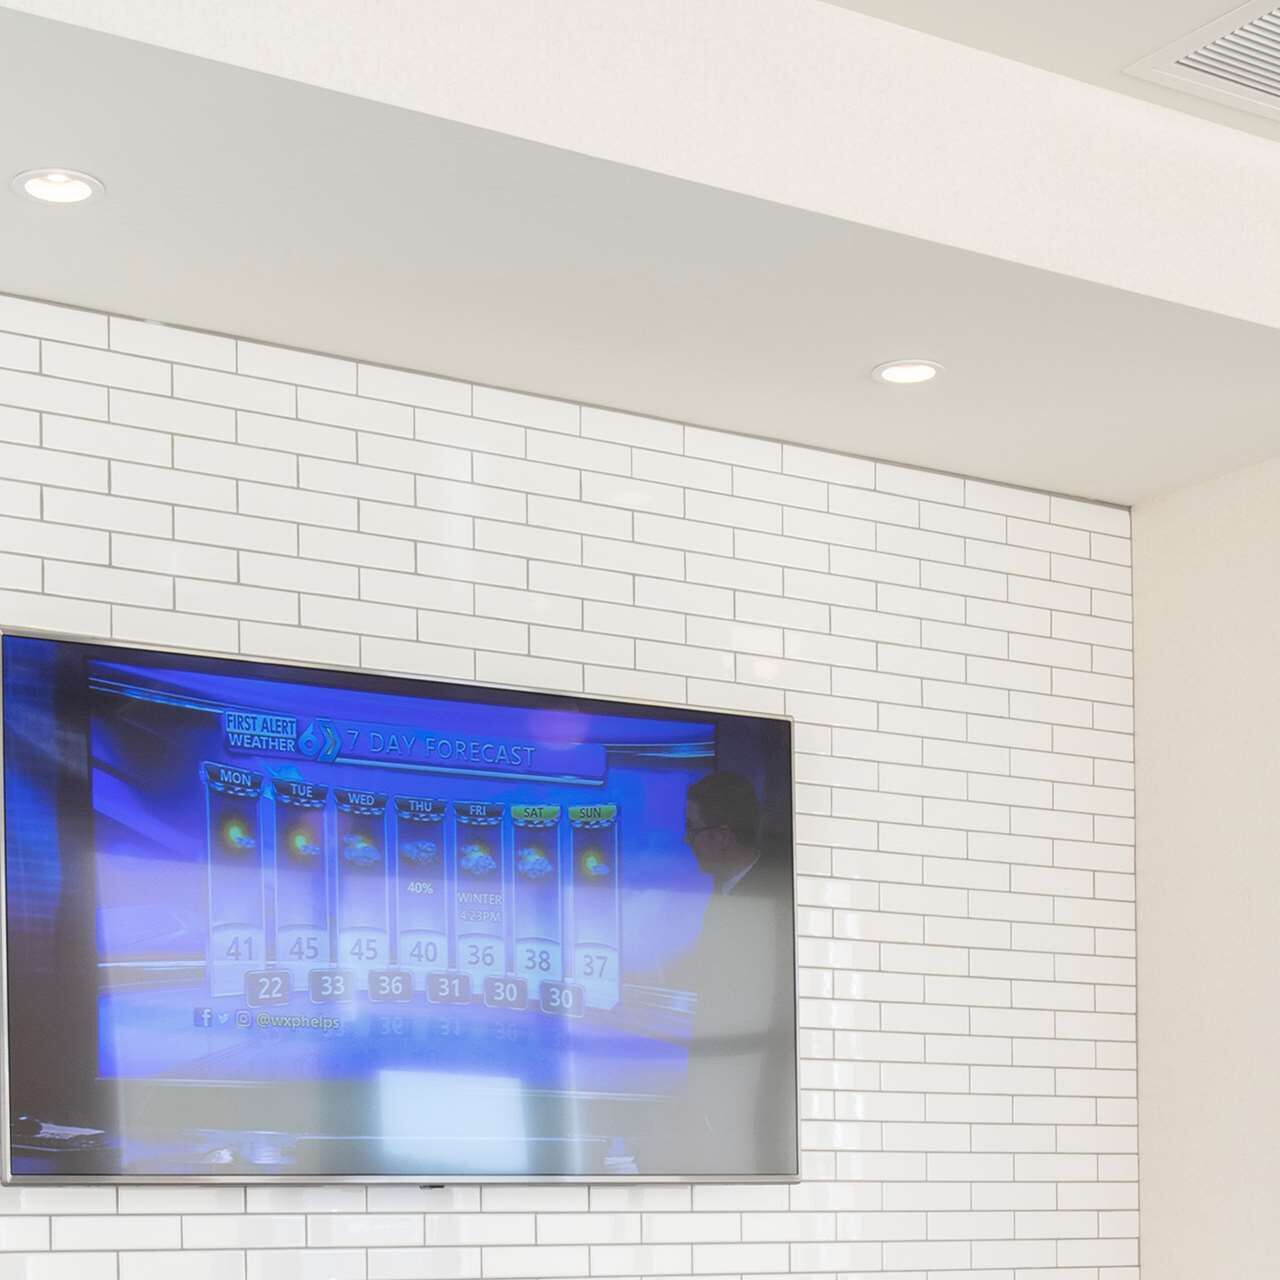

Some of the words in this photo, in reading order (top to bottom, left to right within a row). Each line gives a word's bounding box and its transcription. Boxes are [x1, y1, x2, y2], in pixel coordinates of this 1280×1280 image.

[226, 712, 258, 732] FIRST
[261, 716, 297, 736] ALERT
[228, 733, 296, 752] WEATHER
[347, 730, 360, 748] 7
[370, 732, 417, 754] DAY
[426, 738, 536, 766] FORECAST
[220, 769, 252, 786] MON
[290, 783, 313, 798] TUE
[348, 792, 375, 806] WED
[409, 800, 433, 813] THU
[470, 804, 487, 816] FRI
[524, 808, 544, 818] SAT
[580, 808, 602, 818] SUN
[407, 881, 434, 895] 40%
[458, 892, 503, 905] WINTER
[226, 937, 254, 961] 41
[289, 937, 320, 960] 45
[350, 938, 378, 961] 45
[410, 941, 438, 962] 40
[467, 944, 495, 966] 36
[524, 949, 552, 972] 38
[583, 954, 609, 978] 37
[258, 977, 283, 999] 22
[321, 976, 345, 995] 33
[378, 976, 403, 995] 36
[438, 979, 461, 997] 31
[493, 982, 517, 1002] 30
[549, 987, 573, 1008] 30
[256, 1011, 341, 1031] @wxphelps
